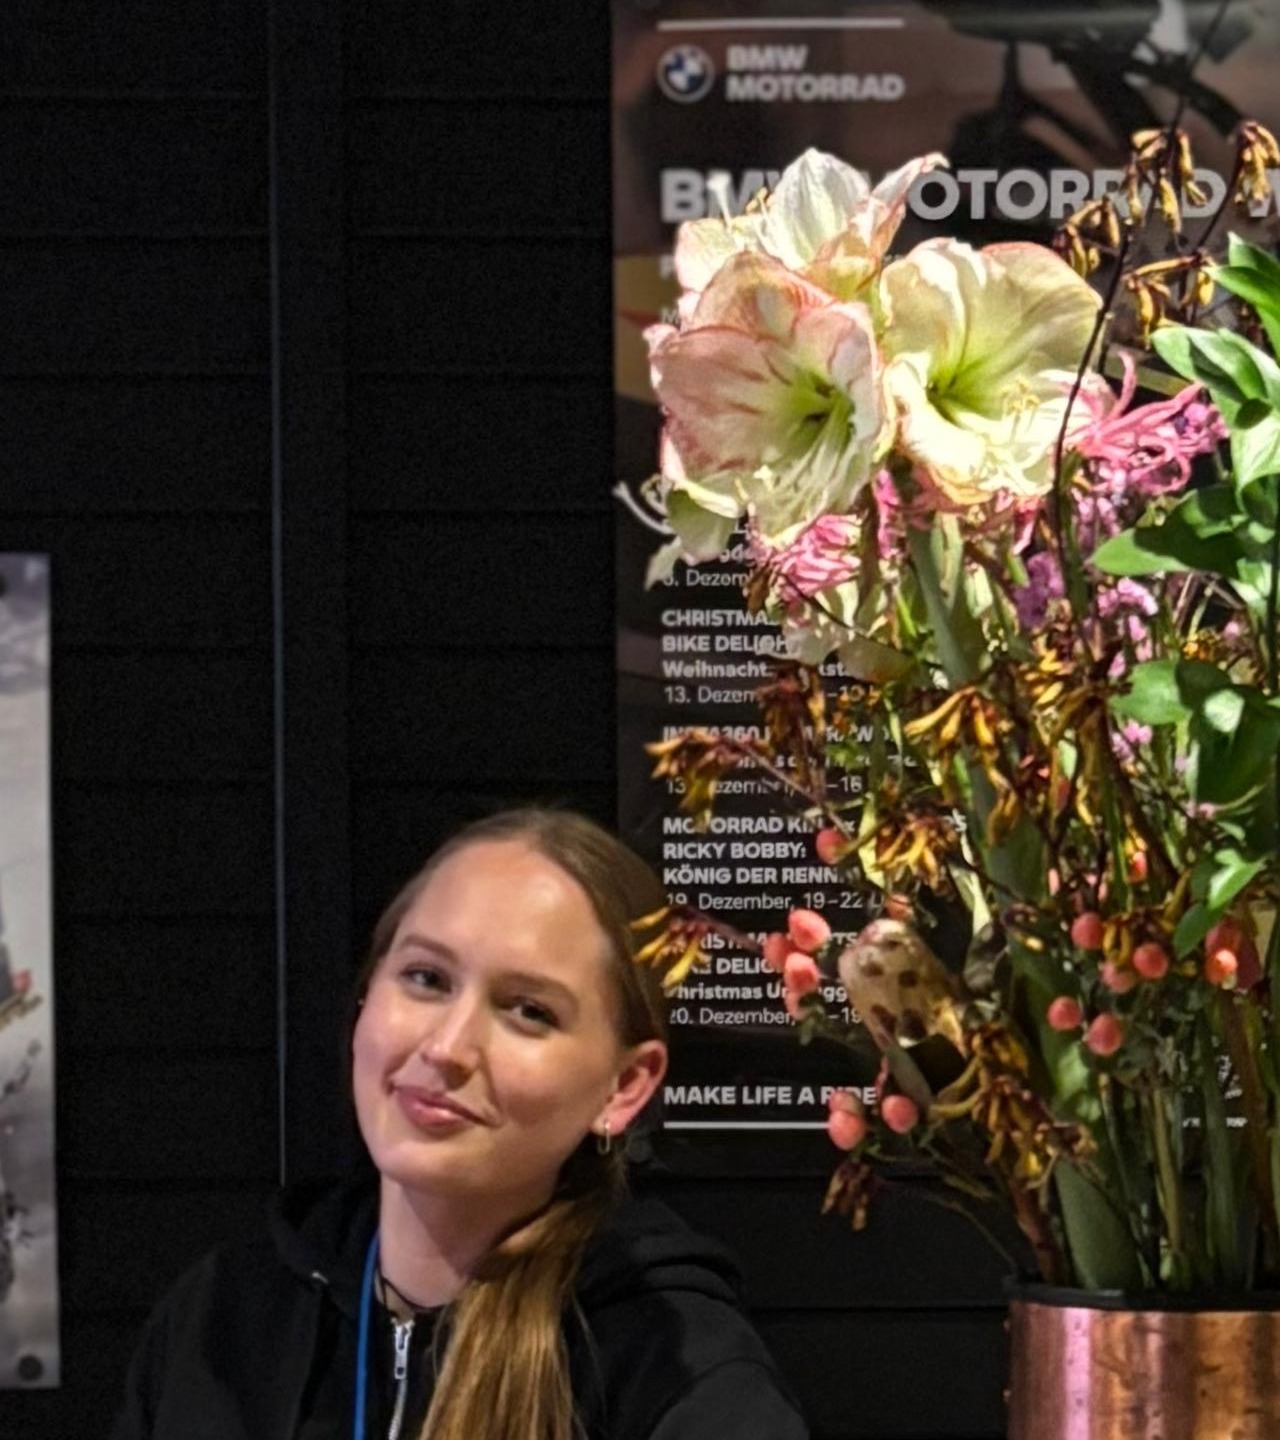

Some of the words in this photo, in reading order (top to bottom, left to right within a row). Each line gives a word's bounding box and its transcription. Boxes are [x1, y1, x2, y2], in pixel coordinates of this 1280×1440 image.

[727, 45, 808, 70] BMW
[726, 74, 905, 102] MOTORRAD
[661, 169, 786, 222] BM
[863, 167, 1227, 221] OTORRD
[661, 609, 780, 627] CHRISTMA
[662, 634, 711, 653] BIKE
[663, 816, 784, 834] MOORRAD
[663, 842, 727, 859] RICKY
[663, 863, 732, 885] KÖNIG
[736, 867, 778, 884] DER
[663, 1085, 736, 1105] MAKE
[742, 1085, 792, 1105] LIFE
[796, 1086, 815, 1105] A
[821, 1085, 877, 1105] RE
